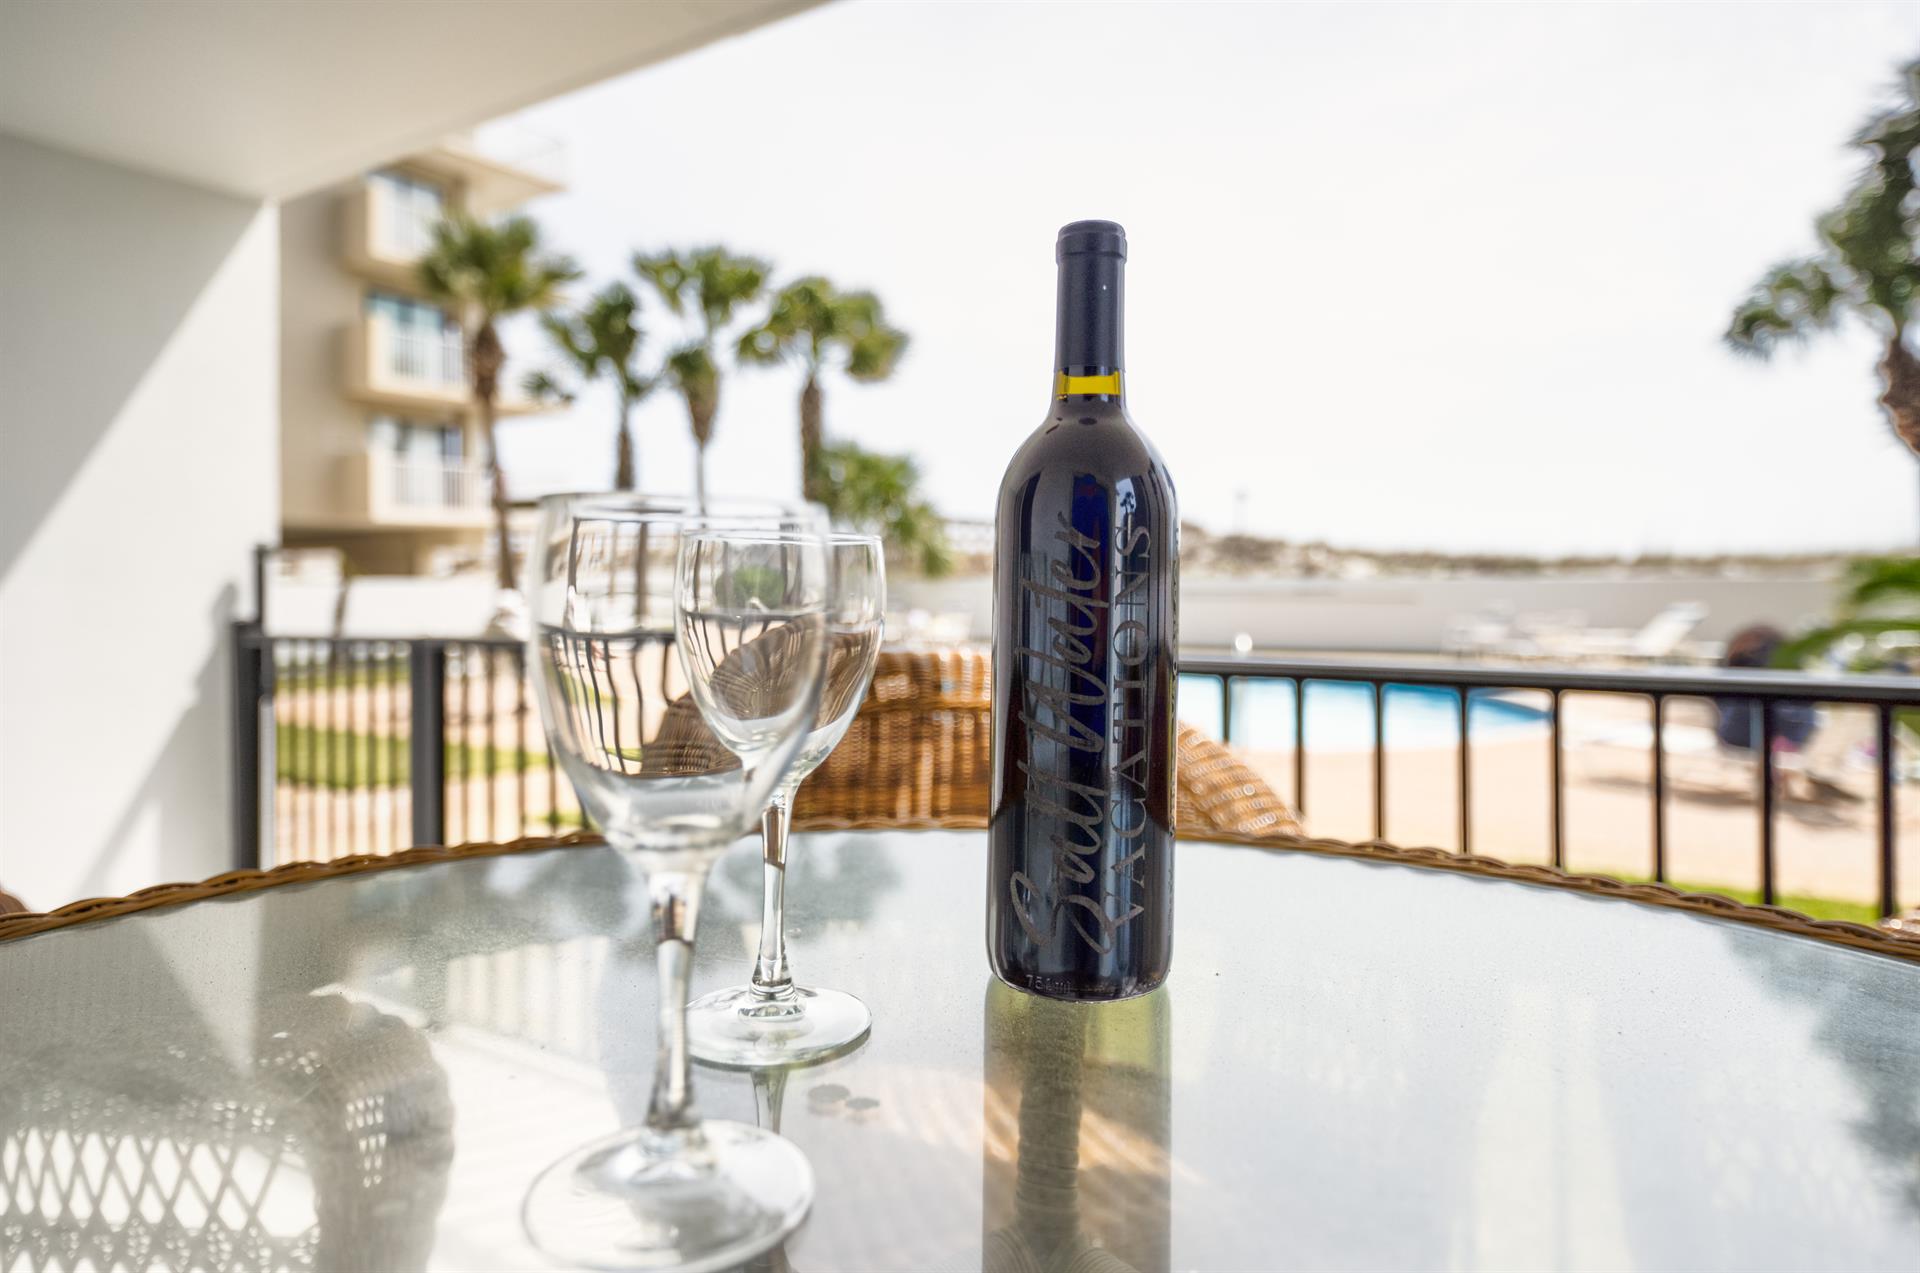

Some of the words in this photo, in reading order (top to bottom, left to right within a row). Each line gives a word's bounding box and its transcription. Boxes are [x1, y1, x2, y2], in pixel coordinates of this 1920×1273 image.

[1014, 511, 1110, 752] Water
[1105, 526, 1151, 931] VACATIONS
[1010, 757, 1112, 955] Salt
